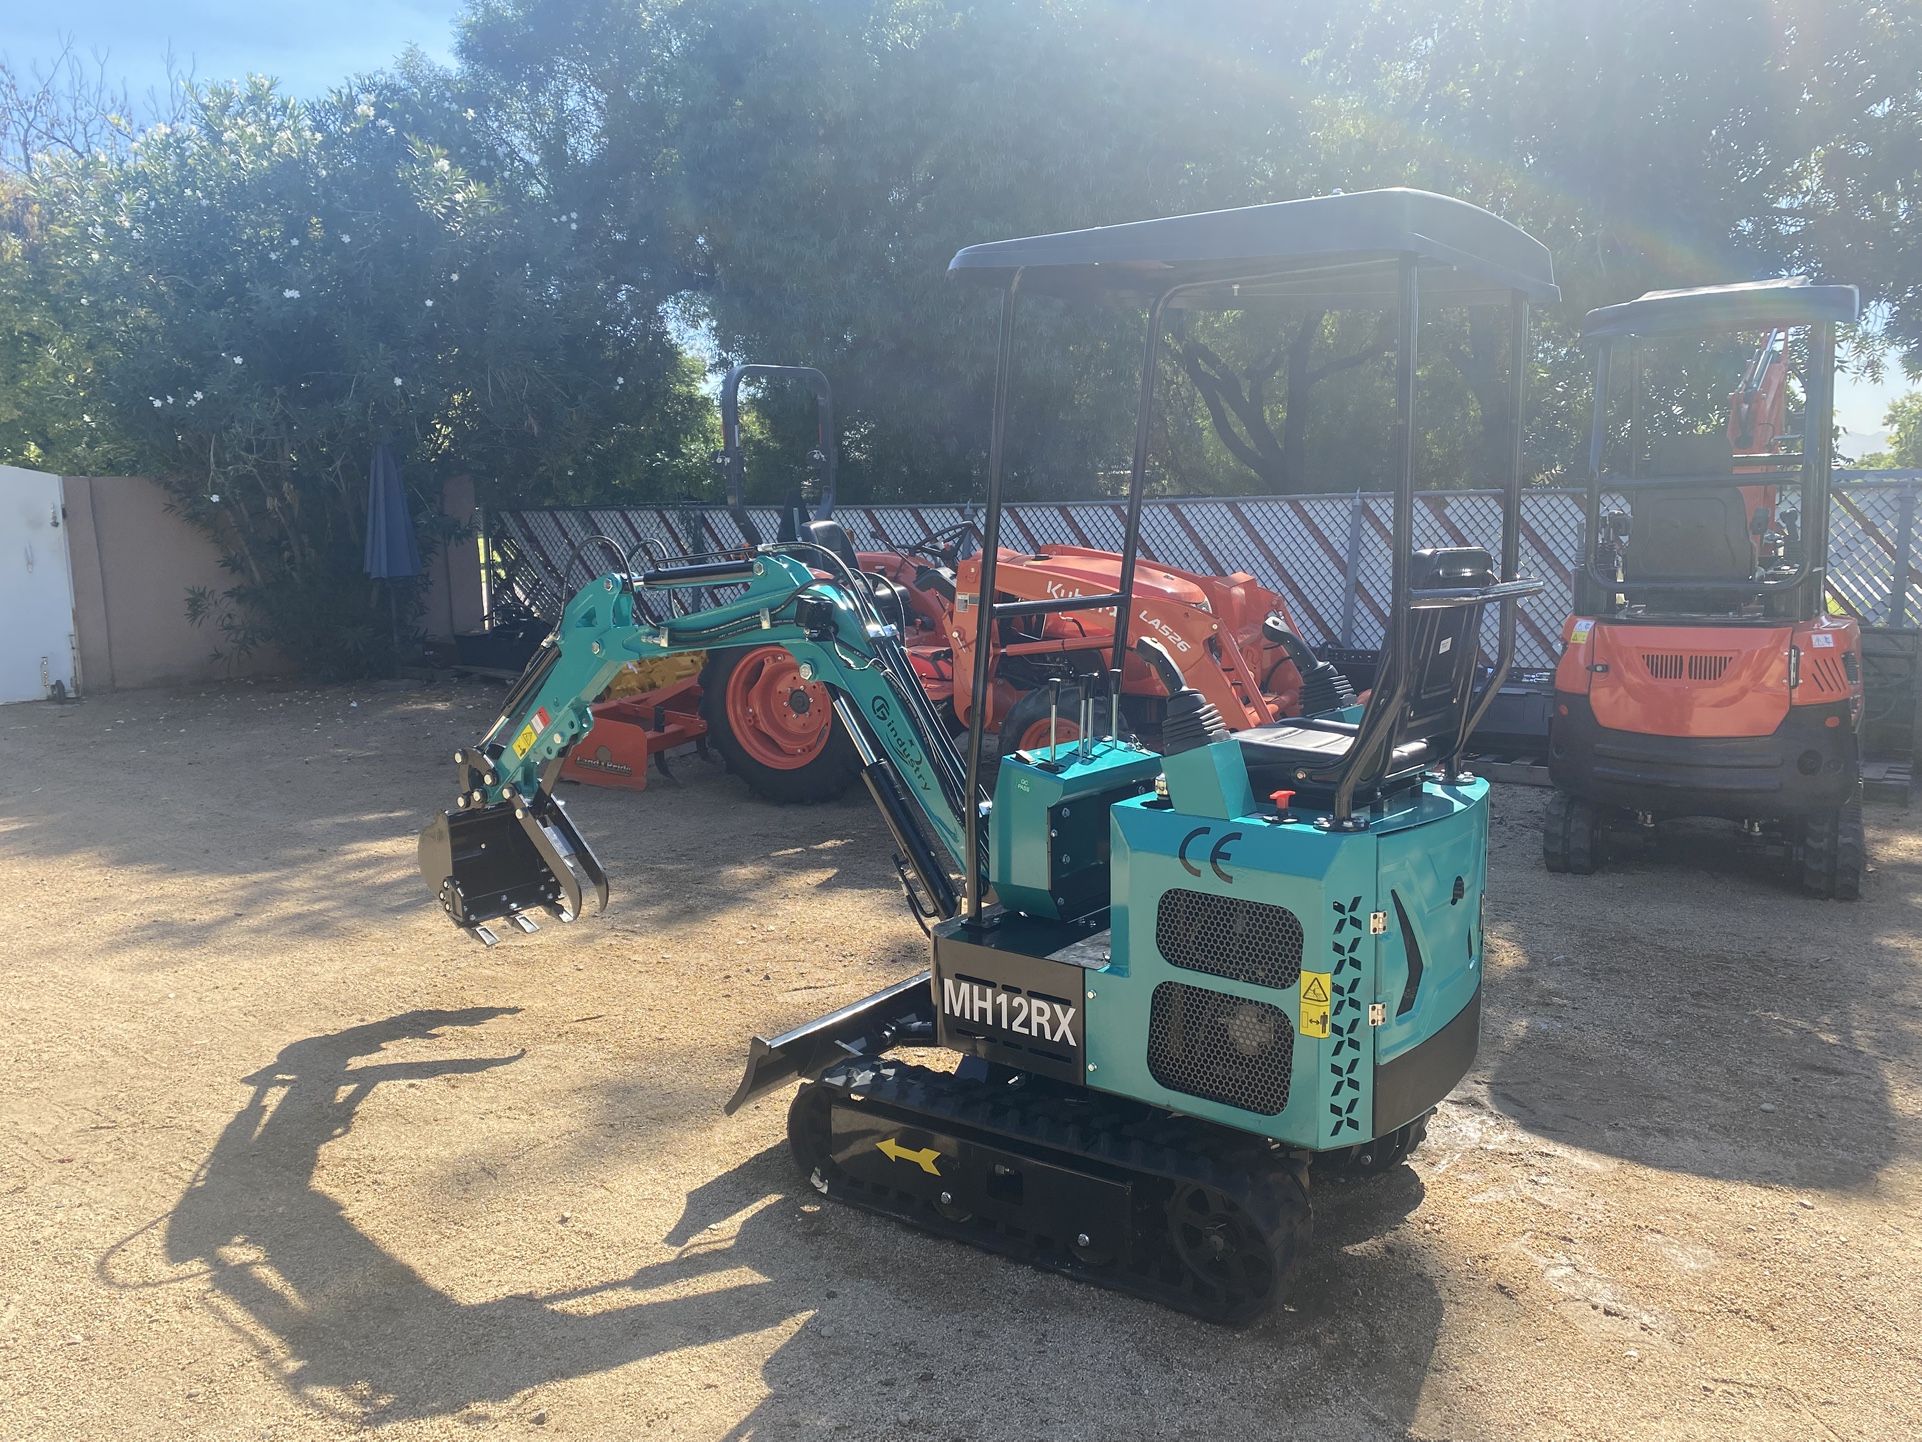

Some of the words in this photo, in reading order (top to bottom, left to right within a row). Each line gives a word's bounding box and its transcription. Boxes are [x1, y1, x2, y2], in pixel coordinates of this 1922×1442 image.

[1139, 609, 1192, 653] LA526
[1178, 826, 1242, 884] CE
[943, 978, 1077, 1047] MH12RX
